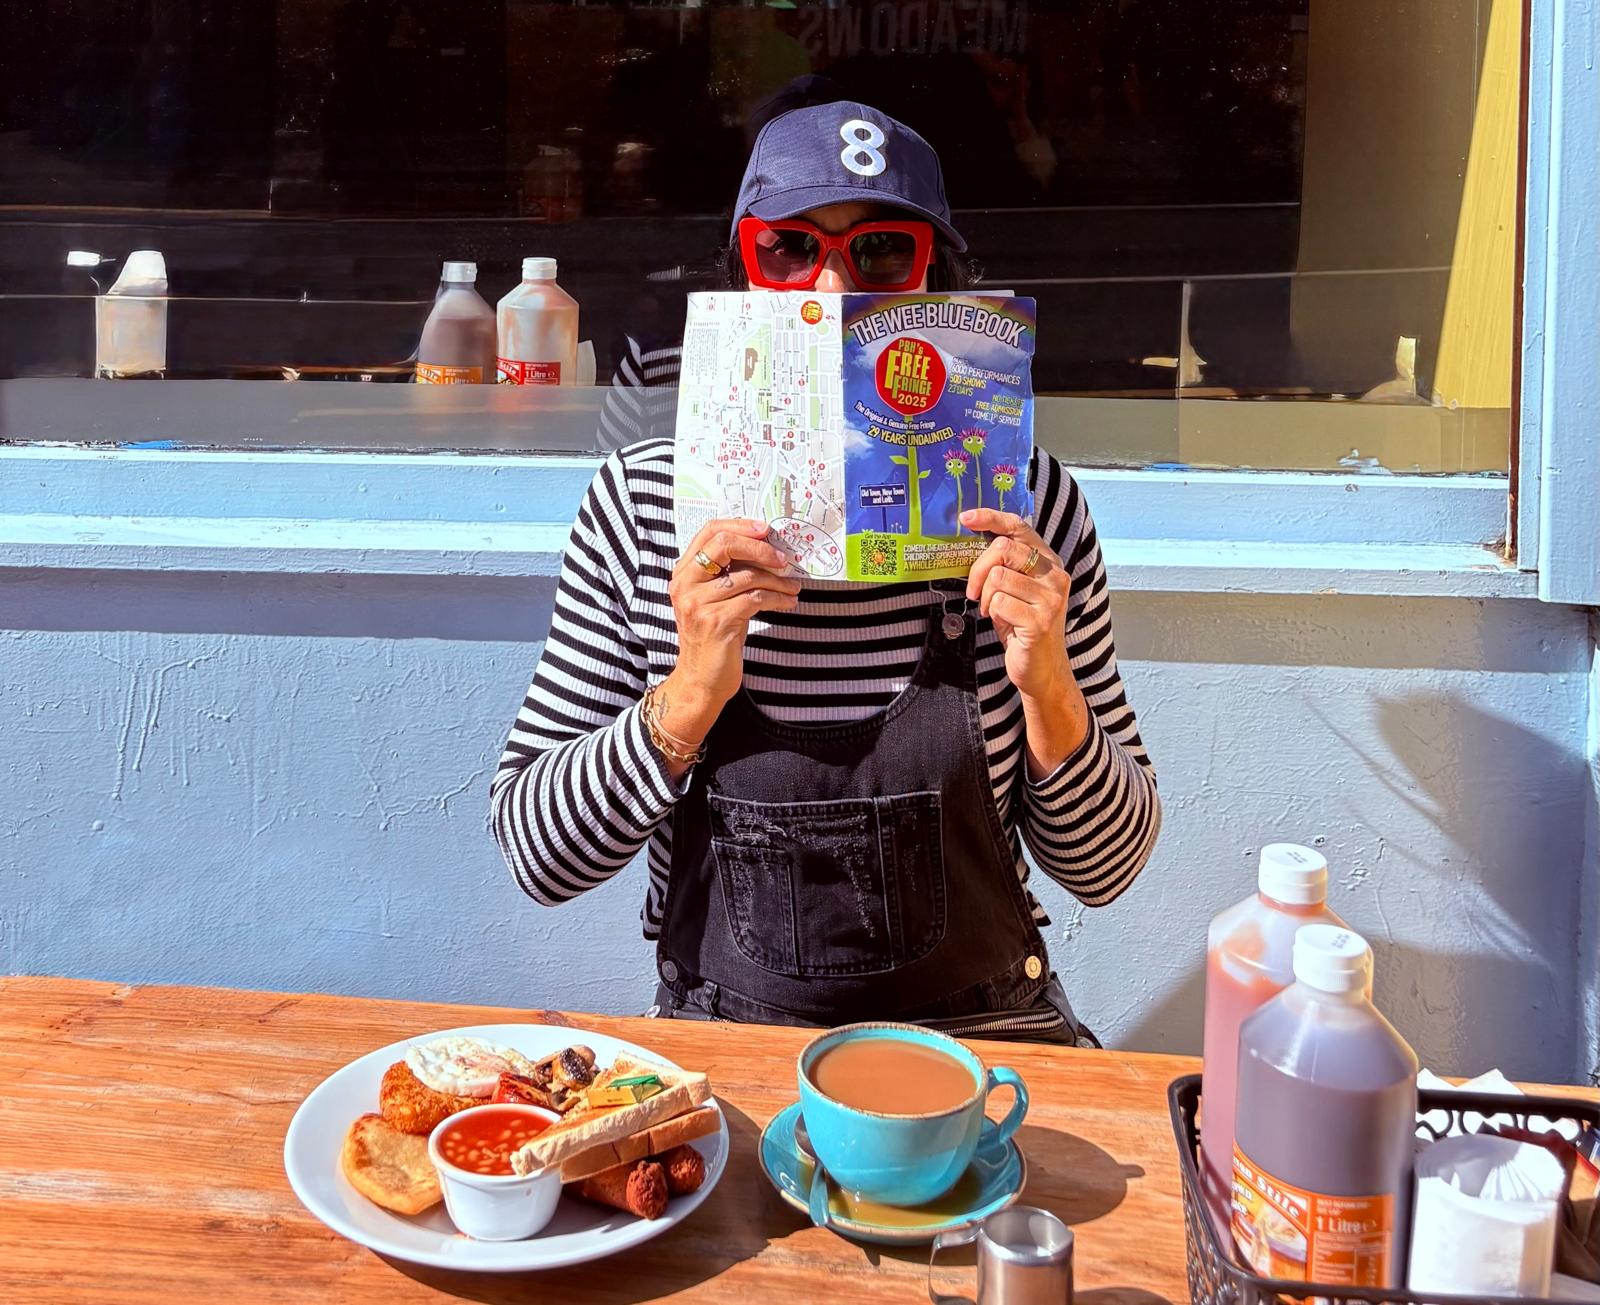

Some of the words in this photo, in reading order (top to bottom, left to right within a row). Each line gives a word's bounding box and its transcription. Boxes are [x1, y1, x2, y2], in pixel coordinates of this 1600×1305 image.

[840, 120, 886, 176] 8
[850, 314, 887, 347] THE
[883, 304, 924, 333] WEE
[926, 303, 972, 332] BLUE
[973, 309, 1028, 347] BOOK
[899, 340, 924, 355] PBH's
[884, 350, 931, 389] FREE
[968, 367, 1021, 385] PERFORMANCES
[950, 374, 961, 384] 500
[963, 376, 986, 389] SHOWS
[957, 385, 973, 397] DAYS
[898, 393, 927, 408] 2025
[864, 408, 883, 424] Original
[998, 414, 1020, 426] SERVED
[867, 425, 880, 438] 29
[880, 429, 907, 445] YEARS
[909, 559, 932, 570] WHOLE
[1257, 1175, 1299, 1217] Stile
[1329, 1216, 1360, 1233] Litre
